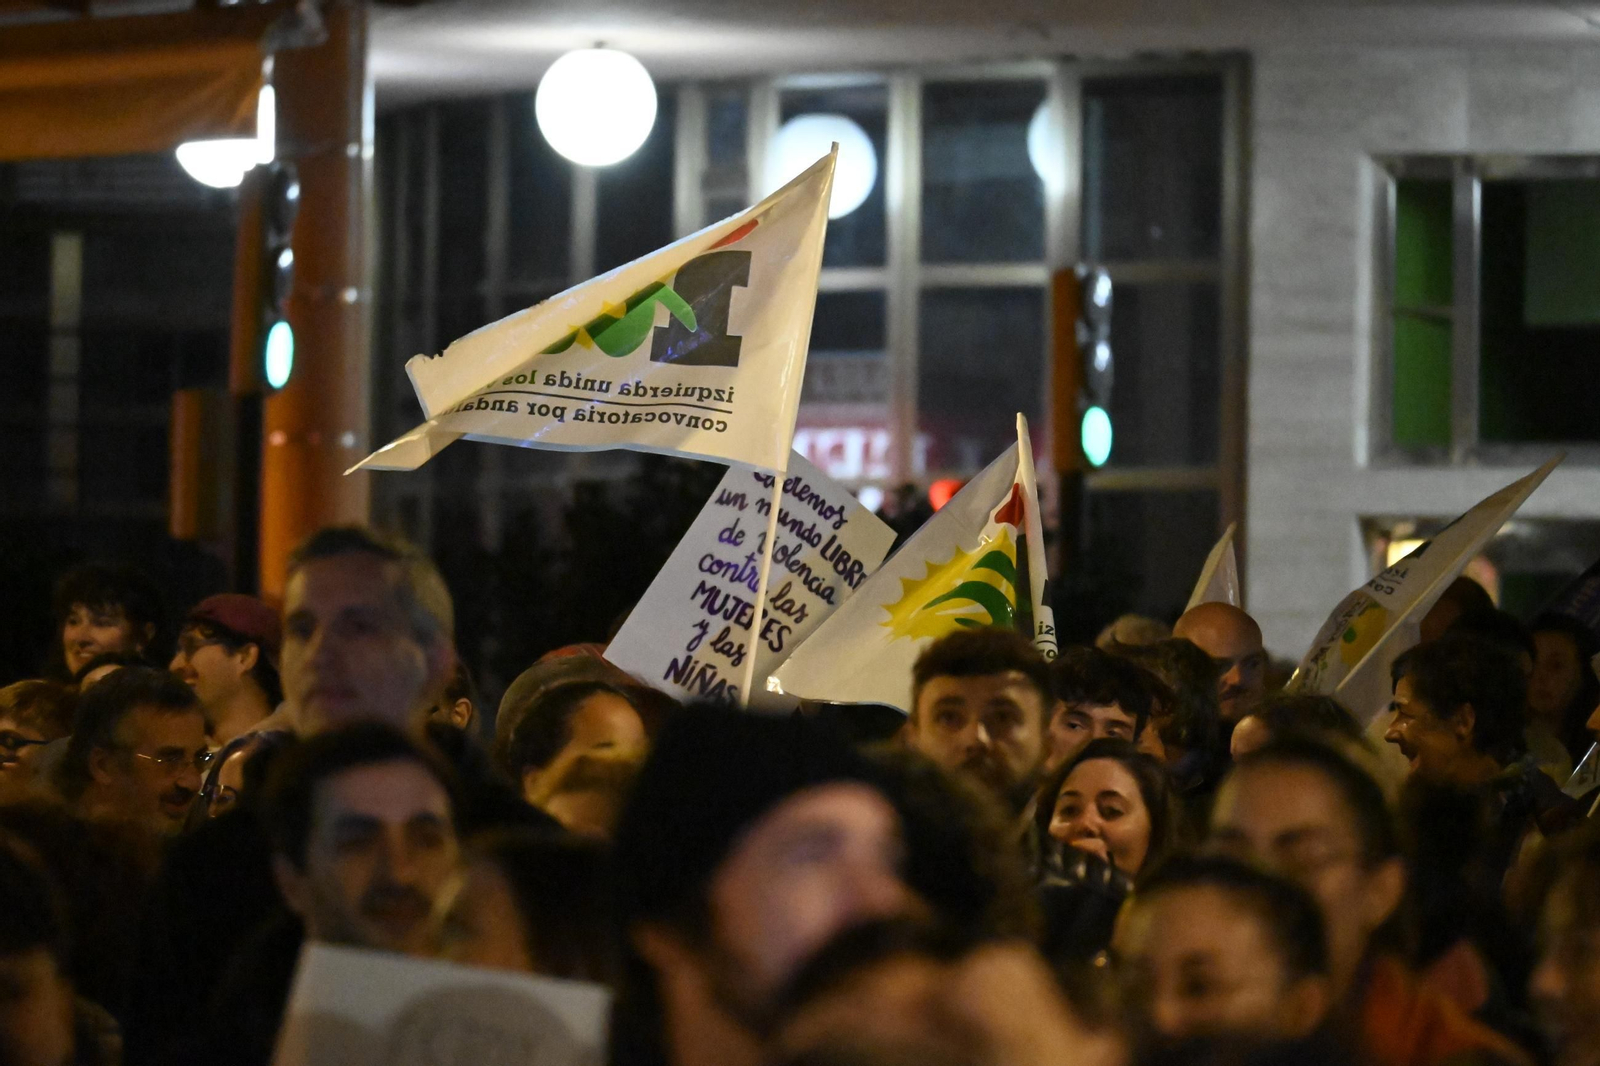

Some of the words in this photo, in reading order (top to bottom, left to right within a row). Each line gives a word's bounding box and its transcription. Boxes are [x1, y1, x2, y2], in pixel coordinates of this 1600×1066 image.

[715, 488, 749, 511] un
[718, 517, 745, 546] de
[769, 581, 808, 624] las
[686, 619, 709, 652] y
[709, 626, 747, 667] las
